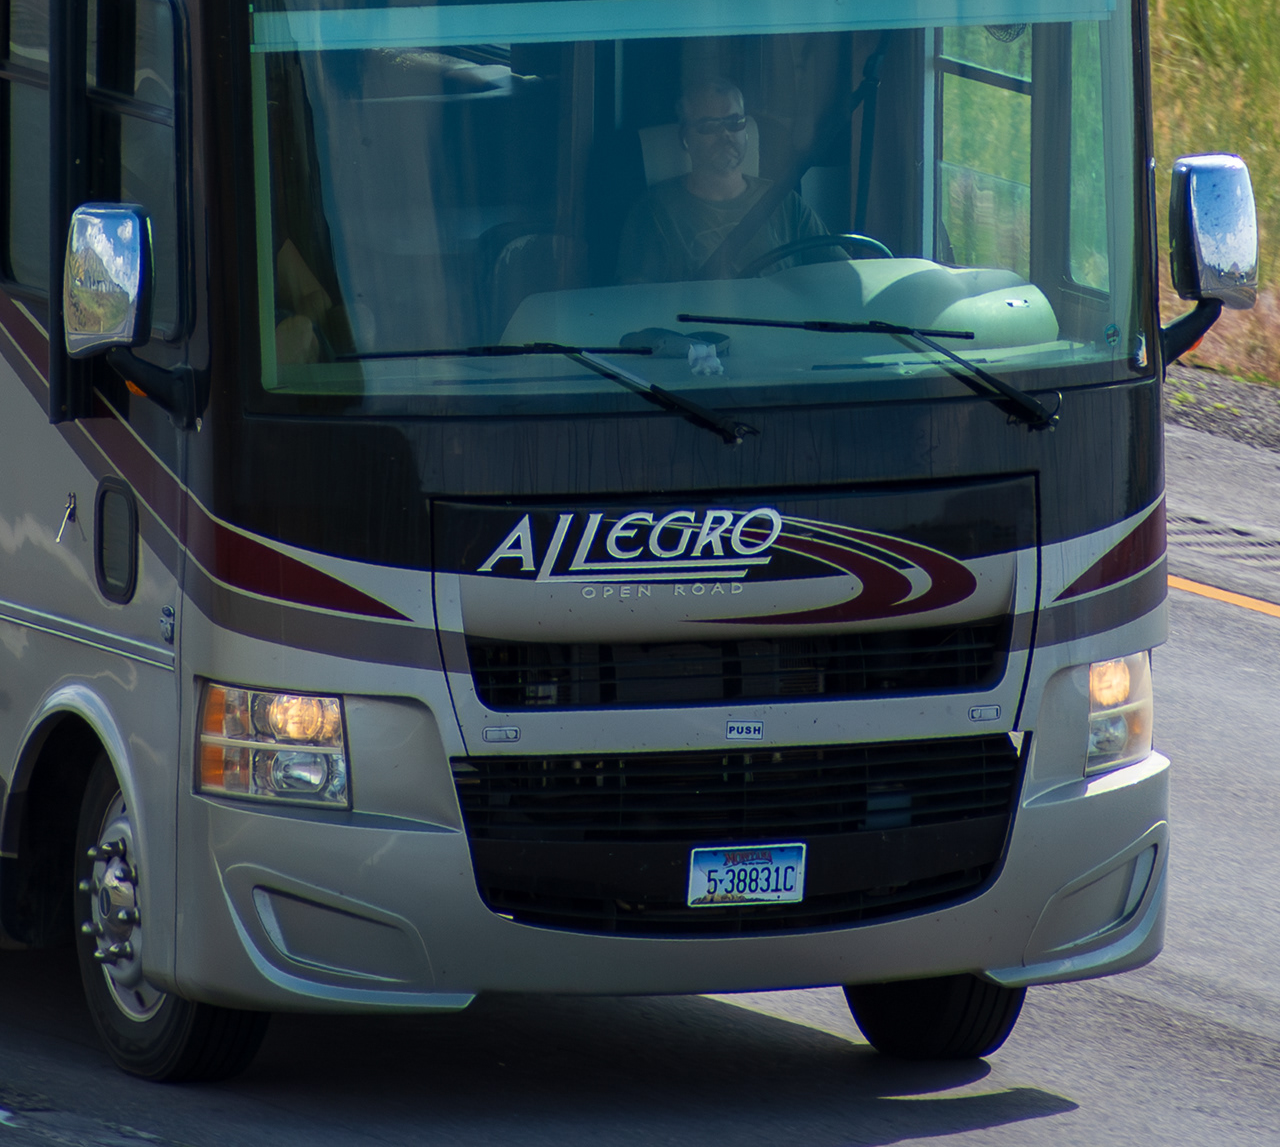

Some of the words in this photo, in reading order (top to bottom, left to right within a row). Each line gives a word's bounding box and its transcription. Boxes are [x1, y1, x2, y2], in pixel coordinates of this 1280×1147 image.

[476, 507, 783, 583] ALLEGRO
[581, 585, 651, 599] OPEN
[674, 582, 744, 596] ROAD
[728, 726, 761, 735] PUSH
